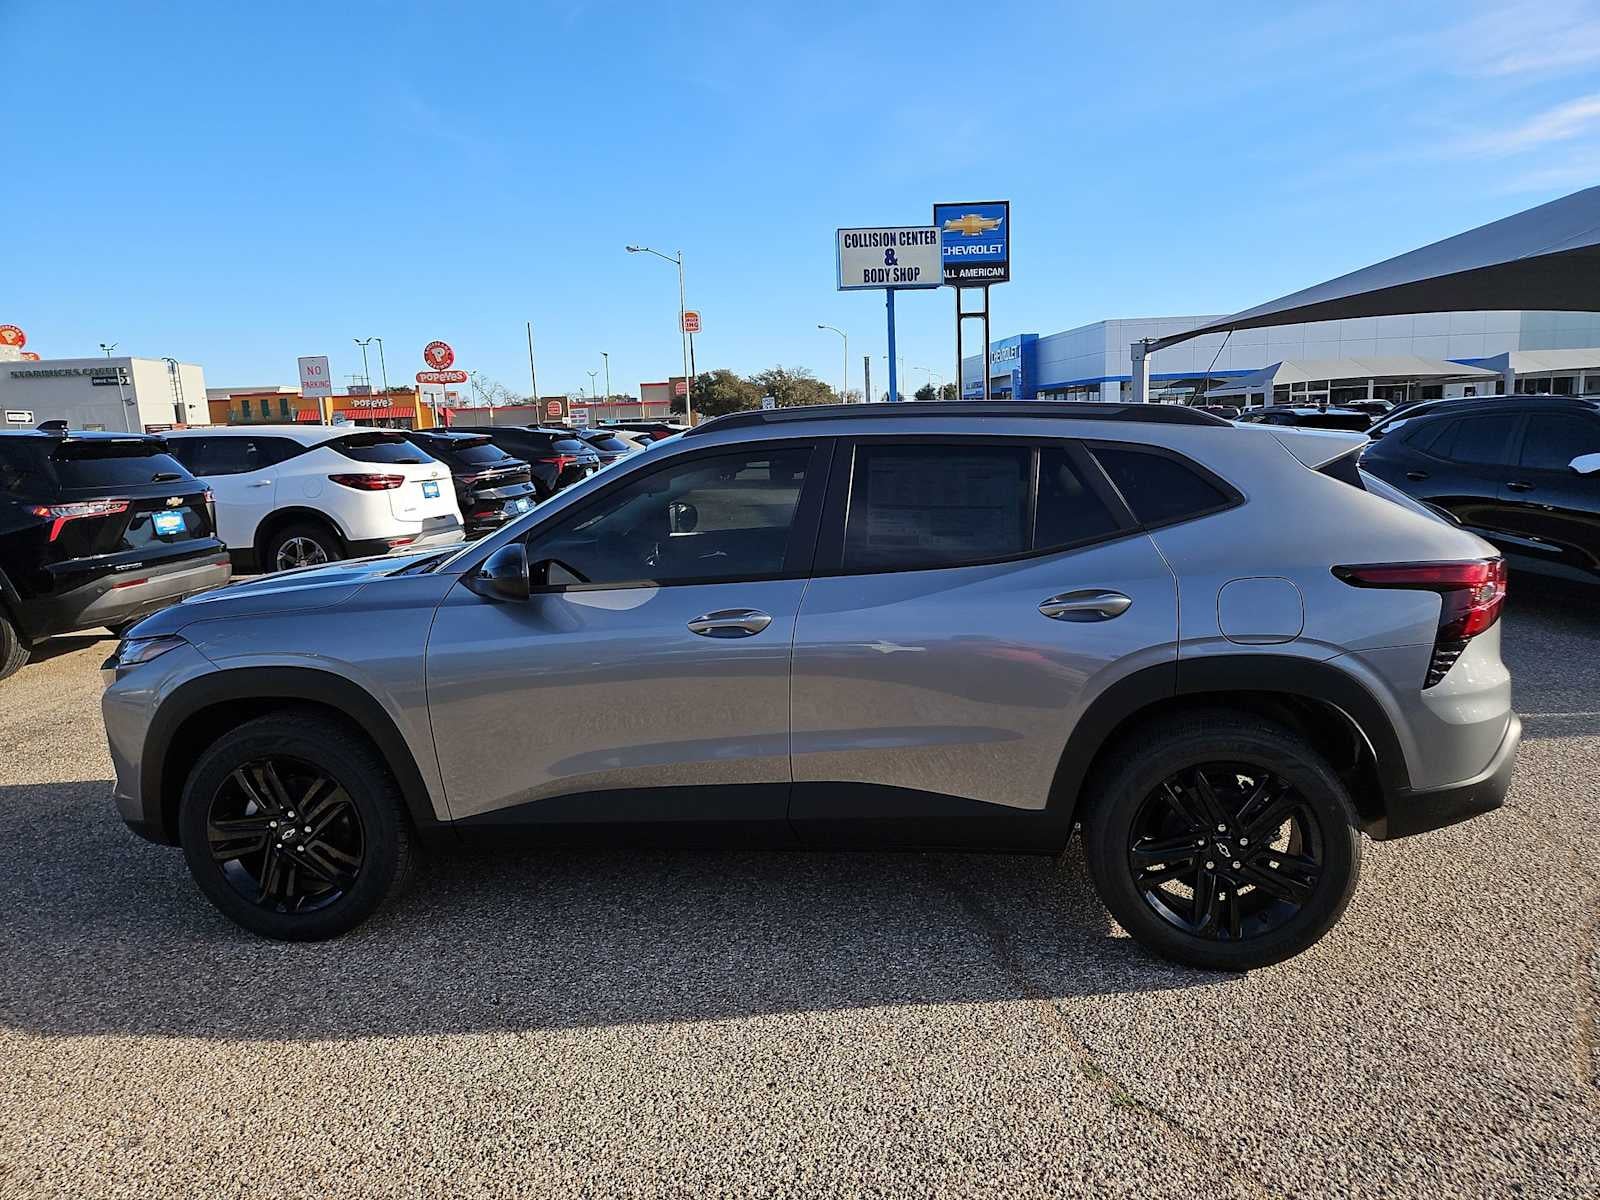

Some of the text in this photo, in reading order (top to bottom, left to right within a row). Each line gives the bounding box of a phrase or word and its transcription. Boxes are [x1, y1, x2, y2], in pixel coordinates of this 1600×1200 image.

[844, 230, 937, 248] COLLISION CENTER
[884, 248, 898, 266] &
[863, 266, 921, 283] BODY SHOP
[959, 267, 1005, 278] AMERICAN
[307, 366, 321, 376] NO
[419, 371, 465, 382] POPEYES
[303, 380, 330, 389] PARKING
[352, 398, 394, 408] POPEYES
